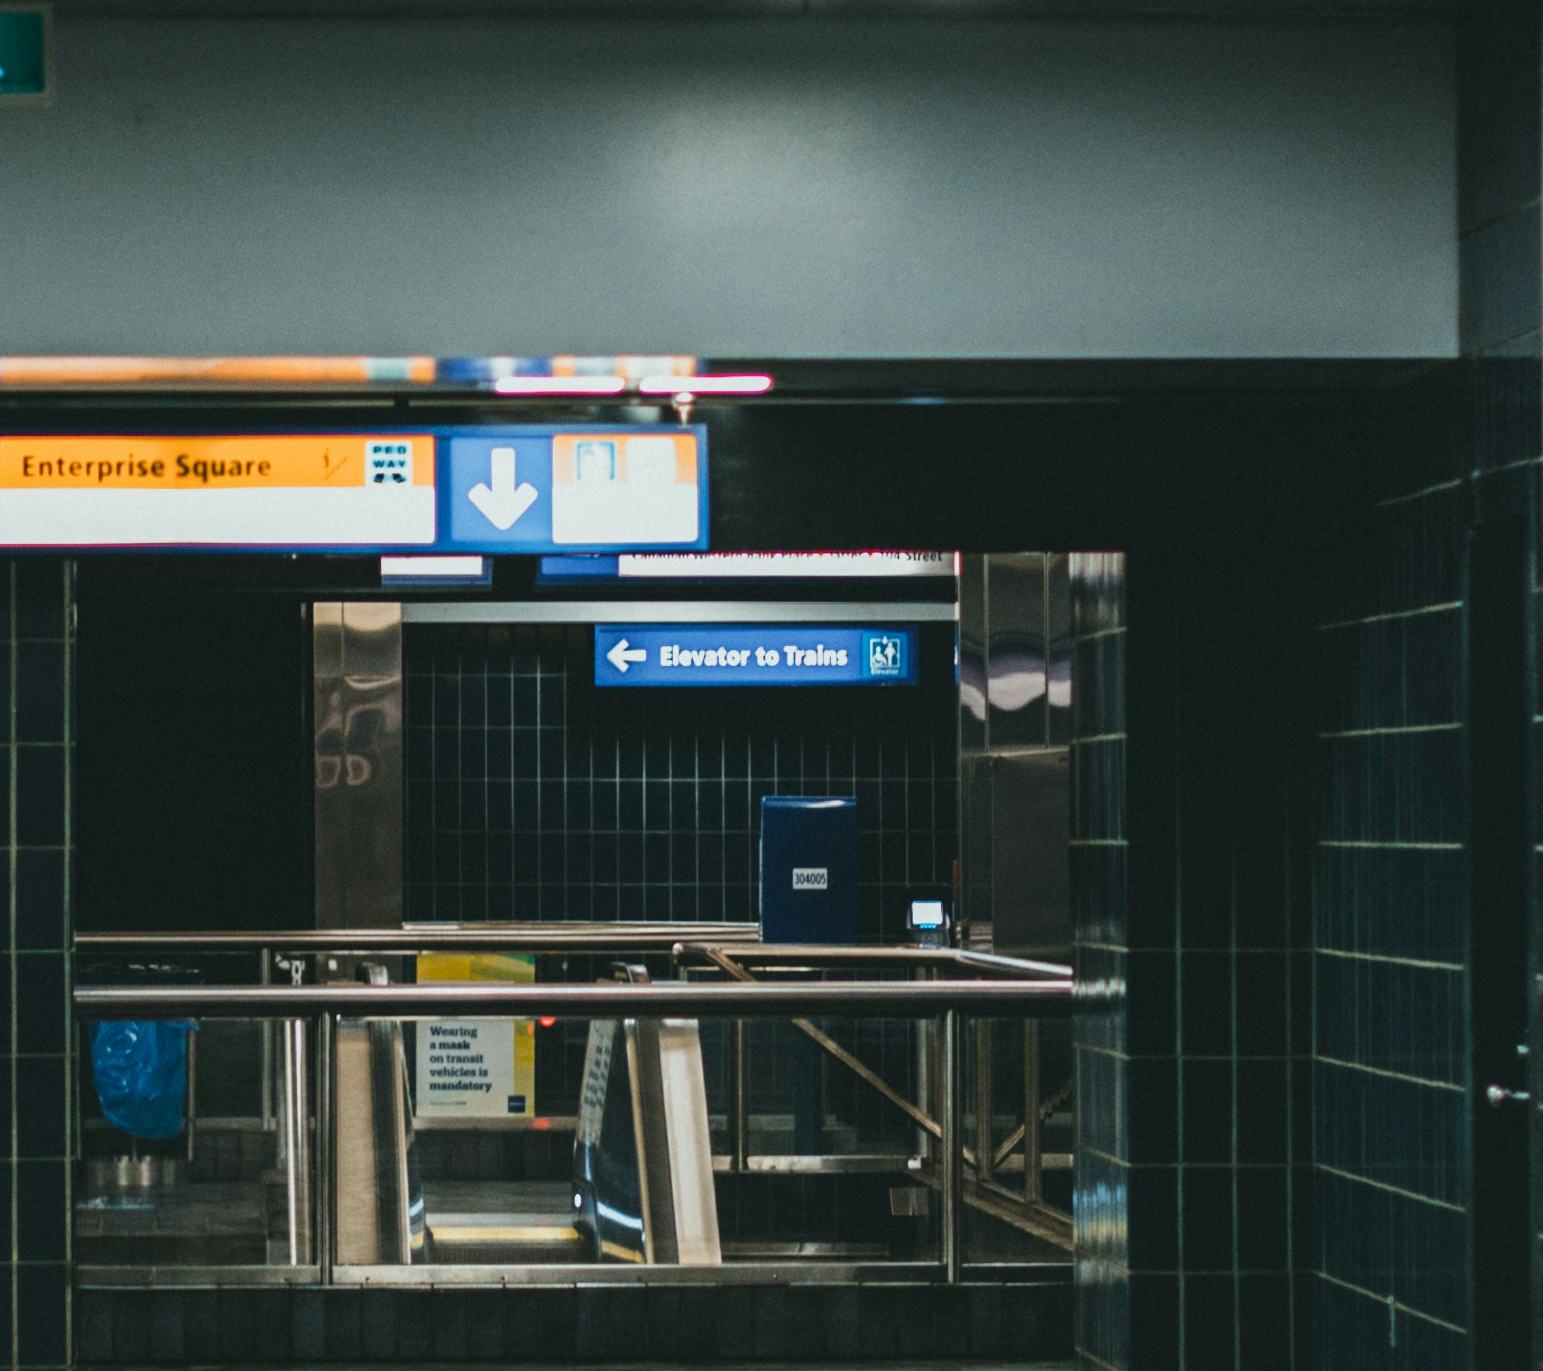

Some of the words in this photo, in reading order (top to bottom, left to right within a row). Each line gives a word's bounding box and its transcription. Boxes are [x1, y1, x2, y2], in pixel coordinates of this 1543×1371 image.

[373, 445, 407, 454] PED
[22, 453, 166, 480] Enterprise
[176, 453, 272, 481] Square
[373, 460, 406, 468] WAY
[659, 645, 751, 667] Elevator
[755, 647, 780, 667] to
[784, 644, 848, 667] Trains
[794, 872, 827, 885] 304005
[429, 1027, 478, 1038] Wearing
[429, 1042, 436, 1050] a
[438, 1040, 471, 1050] mask
[429, 1055, 444, 1064] on
[446, 1053, 484, 1064] transit
[429, 1067, 477, 1077] vehicles
[478, 1067, 489, 1077] is
[429, 1080, 493, 1093] mandatory
